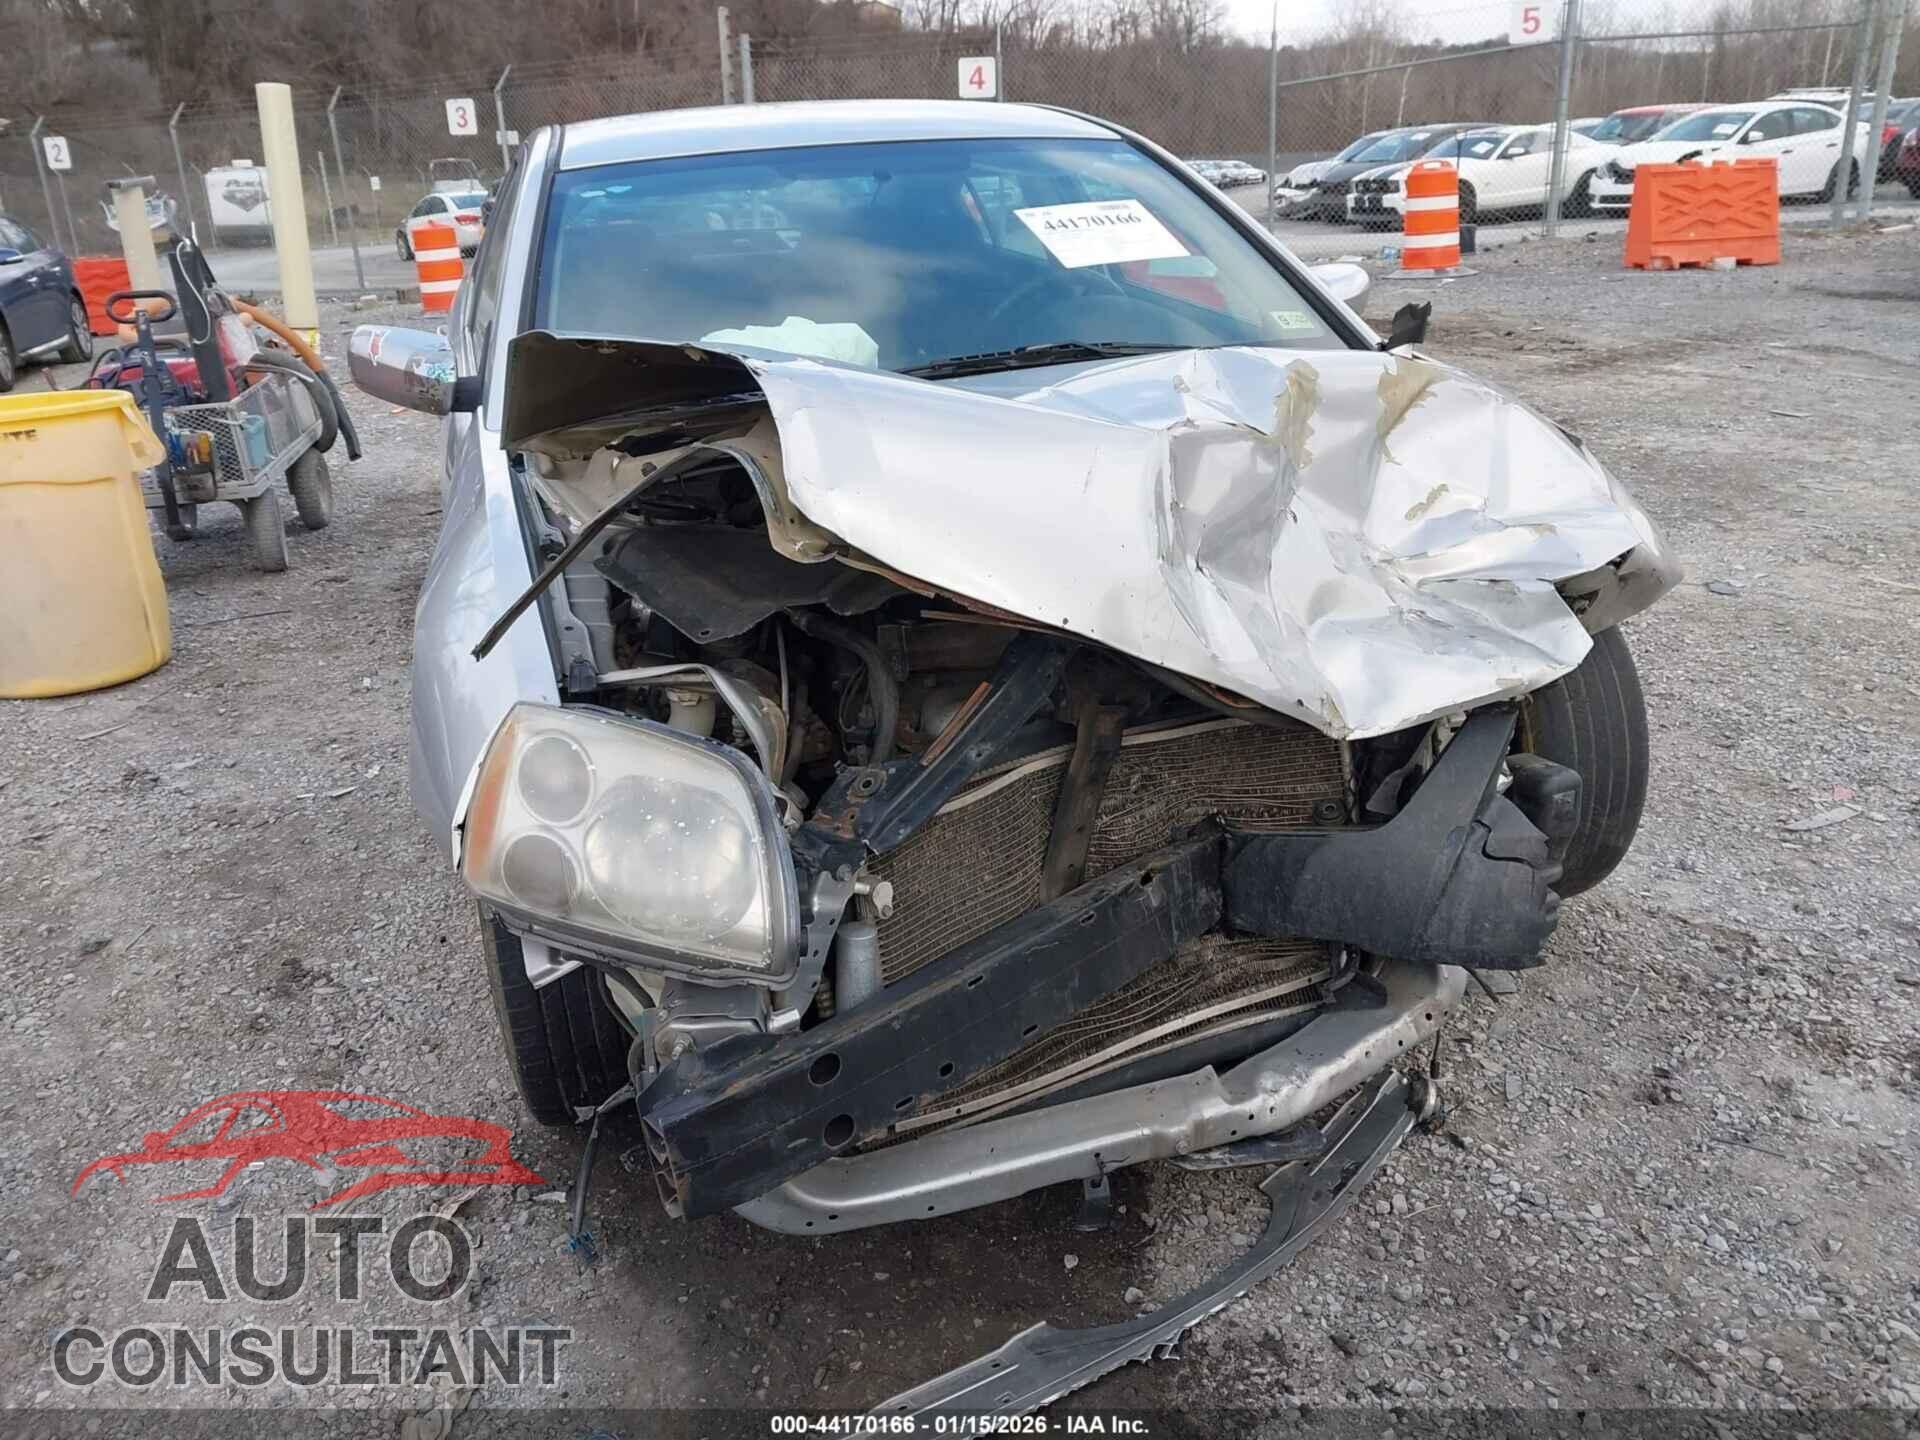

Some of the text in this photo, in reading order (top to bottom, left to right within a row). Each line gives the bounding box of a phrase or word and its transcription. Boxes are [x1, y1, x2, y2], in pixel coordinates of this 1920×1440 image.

[1522, 7, 1541, 34] 5
[969, 65, 986, 90] 4
[455, 106, 468, 128] 3
[51, 143, 64, 163] 2
[1043, 212, 1142, 231] 44170166
